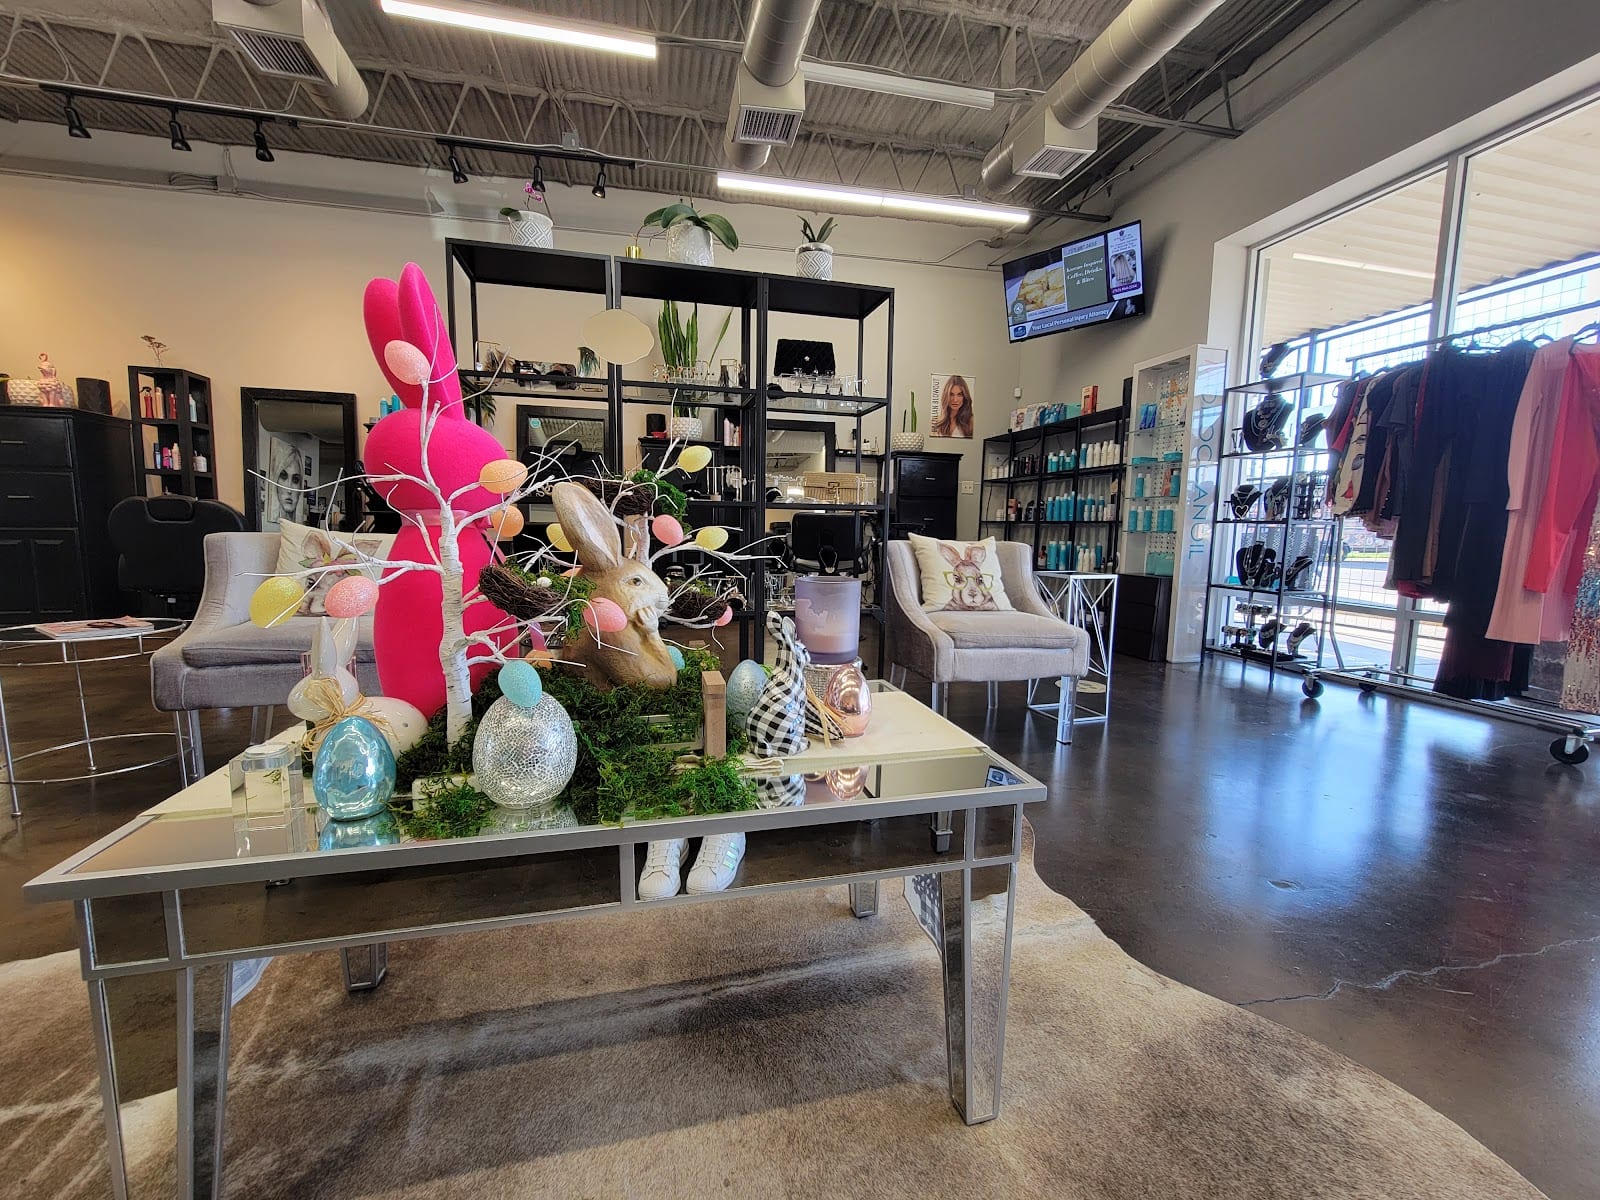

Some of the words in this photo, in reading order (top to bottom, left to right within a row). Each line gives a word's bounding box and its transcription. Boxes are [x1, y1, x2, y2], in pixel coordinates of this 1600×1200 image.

[1042, 321, 1054, 329] Local
[1054, 316, 1074, 326] Personal
[1074, 313, 1088, 322] Injury
[1088, 309, 1109, 318] Attorney
